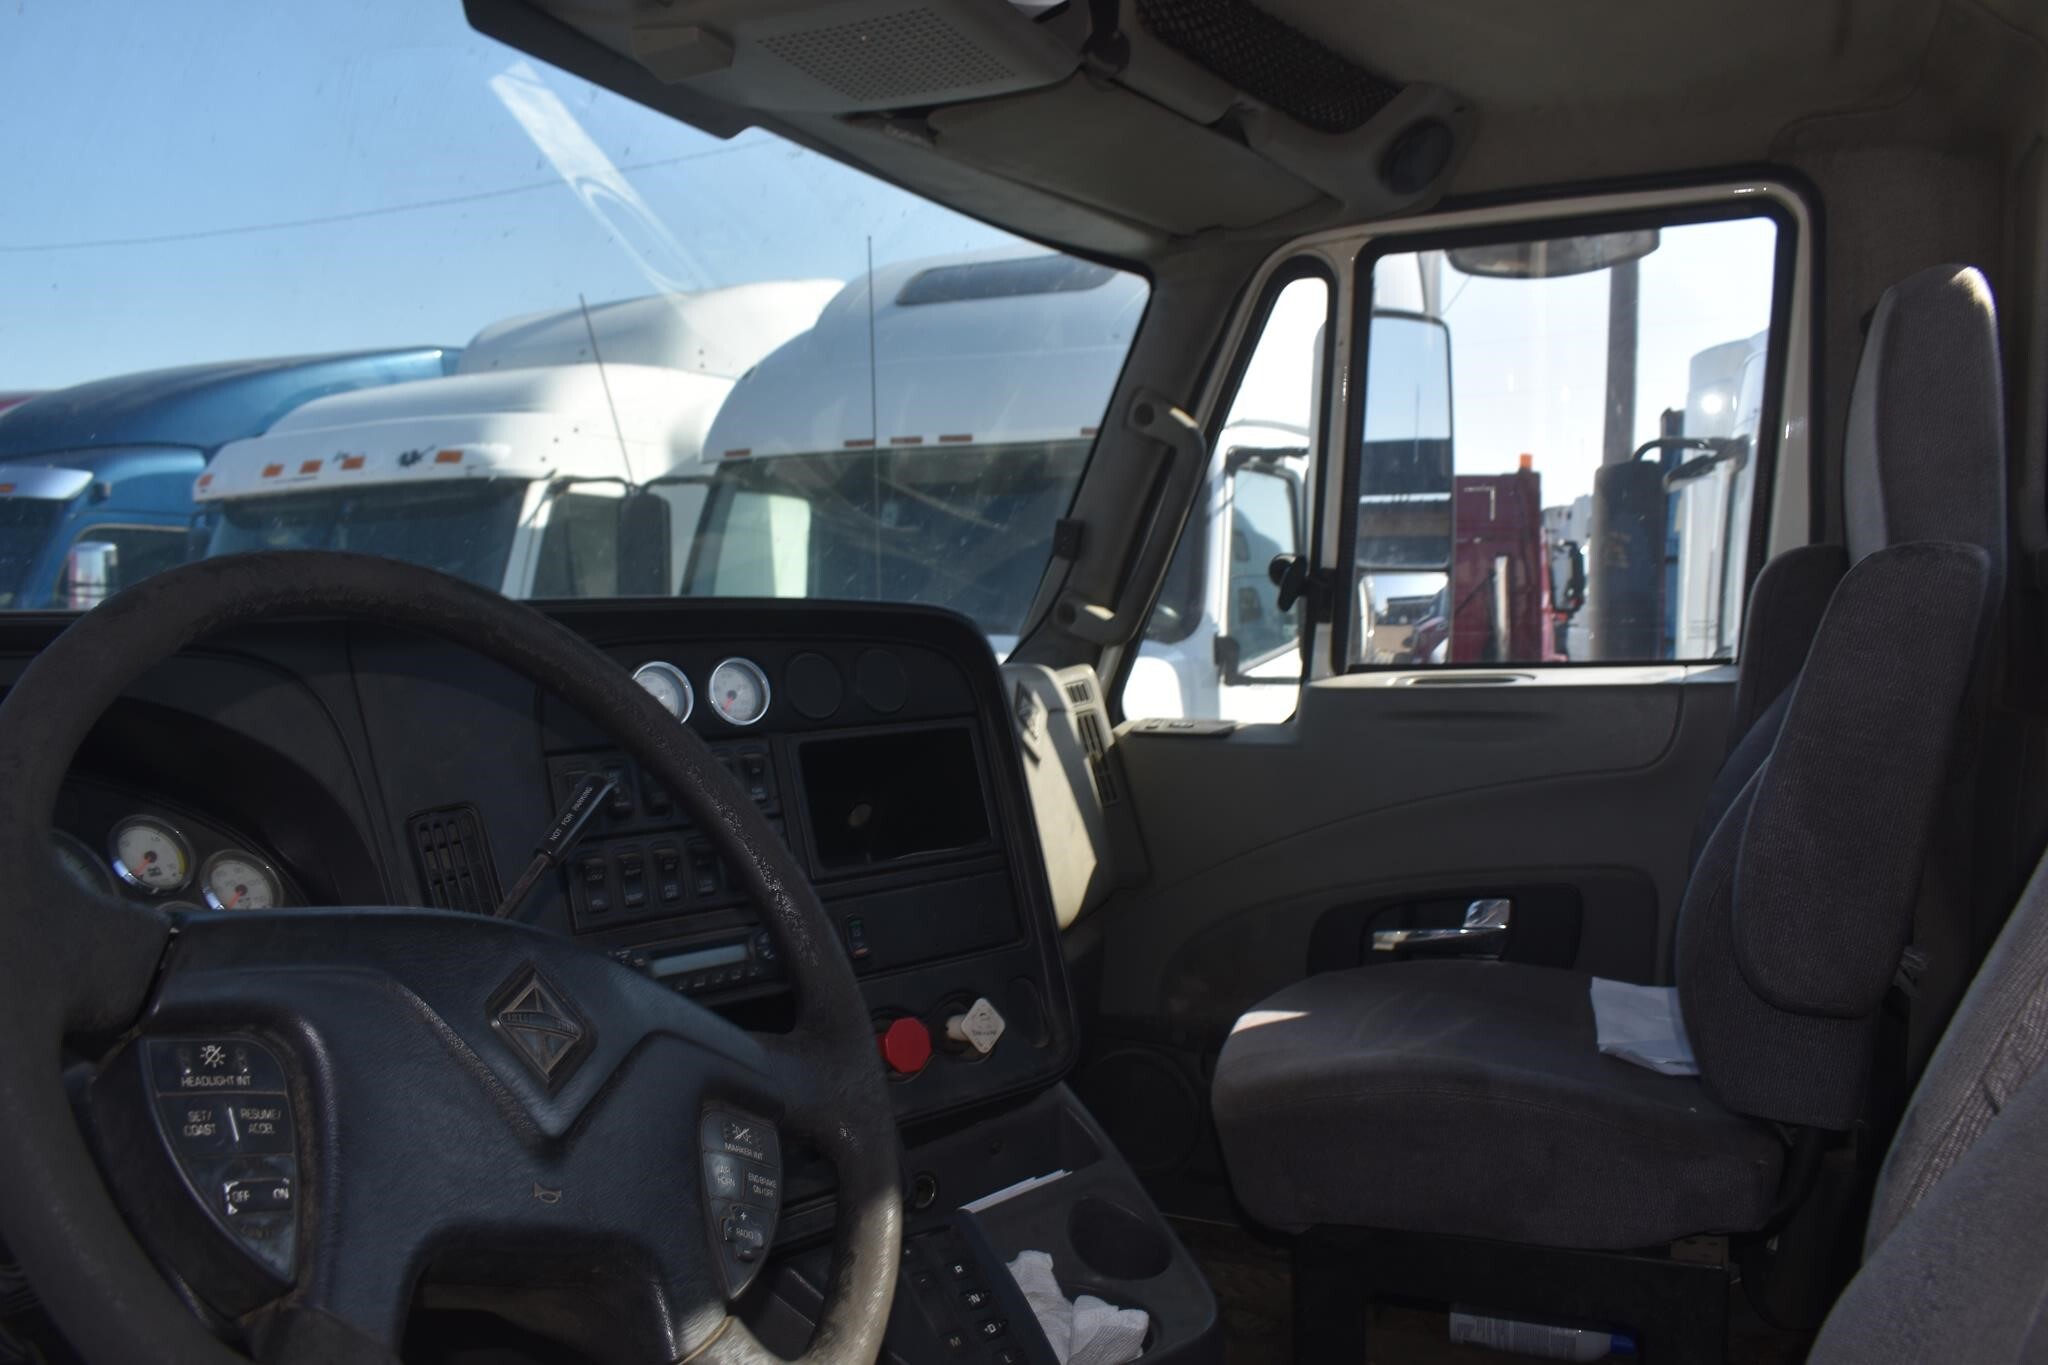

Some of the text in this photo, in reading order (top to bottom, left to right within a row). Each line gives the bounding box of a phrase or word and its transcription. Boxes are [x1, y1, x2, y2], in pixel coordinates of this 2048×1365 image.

[549, 785, 593, 841] NOT FOR PARKING
[181, 1075, 252, 1087] HEADLIGHT INT
[187, 1110, 212, 1122] SET/
[183, 1124, 216, 1136] COAST
[724, 1143, 752, 1156] MARKER
[717, 1176, 736, 1187] HORN
[231, 1190, 250, 1202] OFF
[273, 1188, 289, 1199] ON
[735, 1228, 754, 1240] RADIO
[954, 1264, 963, 1273] R
[970, 1294, 981, 1304] N
[986, 1323, 997, 1334] D
